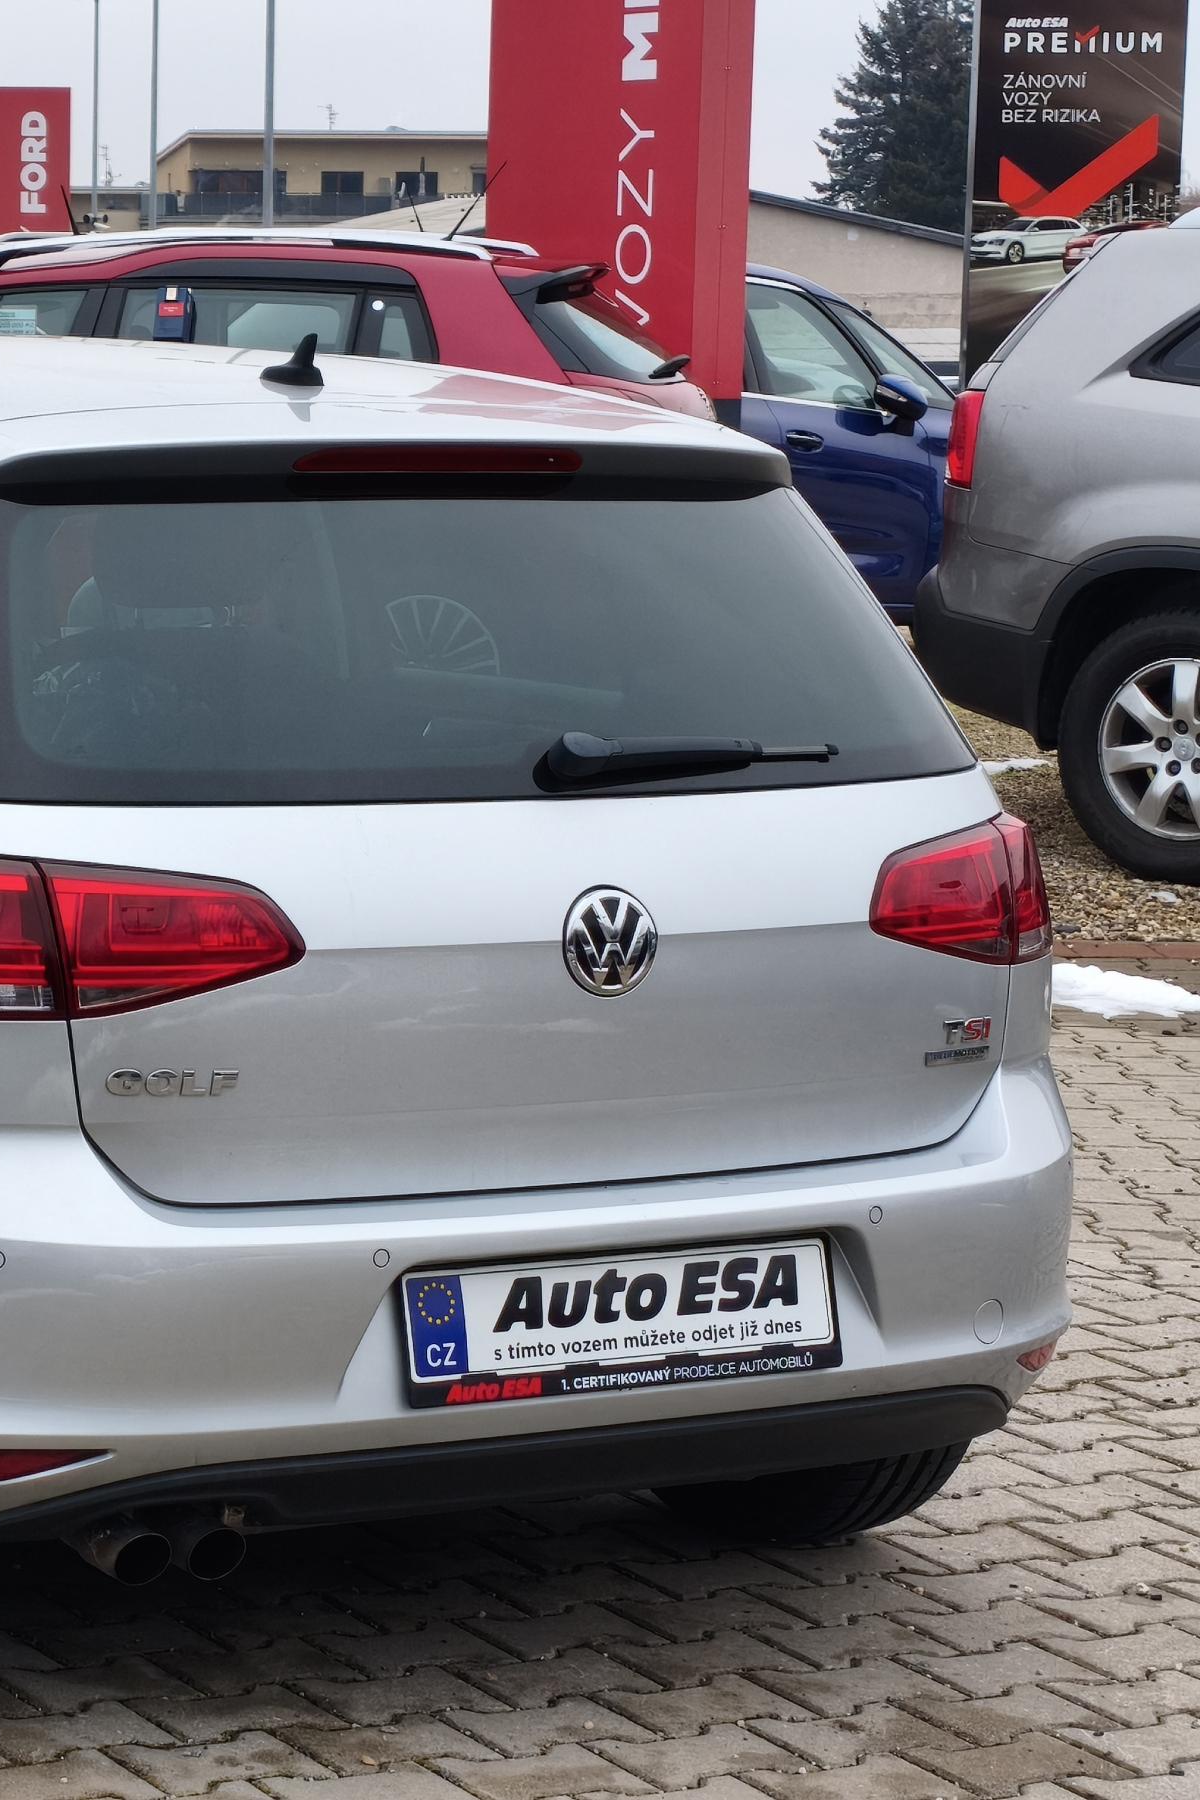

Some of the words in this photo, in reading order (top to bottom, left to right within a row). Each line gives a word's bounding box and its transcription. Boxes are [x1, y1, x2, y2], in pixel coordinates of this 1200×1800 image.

[1005, 17, 1041, 28] Auto
[1041, 17, 1069, 28] ESA
[1003, 30, 1164, 54] PREMIUM
[1002, 71, 1088, 89] ZÁNOVNÍ
[1002, 91, 1052, 106] VOZY
[1001, 109, 1037, 123] BEZ
[1042, 108, 1101, 123] RIZIKA
[20, 110, 47, 213] FORD
[105, 1068, 239, 1097] GOLF
[493, 1269, 667, 1333] Auto
[676, 1254, 798, 1316] ESA
[494, 1349, 503, 1361] s
[508, 1342, 556, 1360] tímto
[560, 1335, 618, 1354] vozem
[623, 1329, 686, 1349] můžete
[691, 1324, 735, 1343] odjet
[739, 1320, 759, 1341] již
[763, 1319, 802, 1335] dnes
[426, 1342, 457, 1368] CZ
[560, 1378, 570, 1391] 1.
[573, 1366, 671, 1390] CERTIFIKOVANÝ
[673, 1361, 737, 1380] PRODEJCE
[738, 1351, 813, 1374] AUTOMOBILŮ
[446, 1381, 500, 1405] Auto
[501, 1375, 542, 1398] ESA
